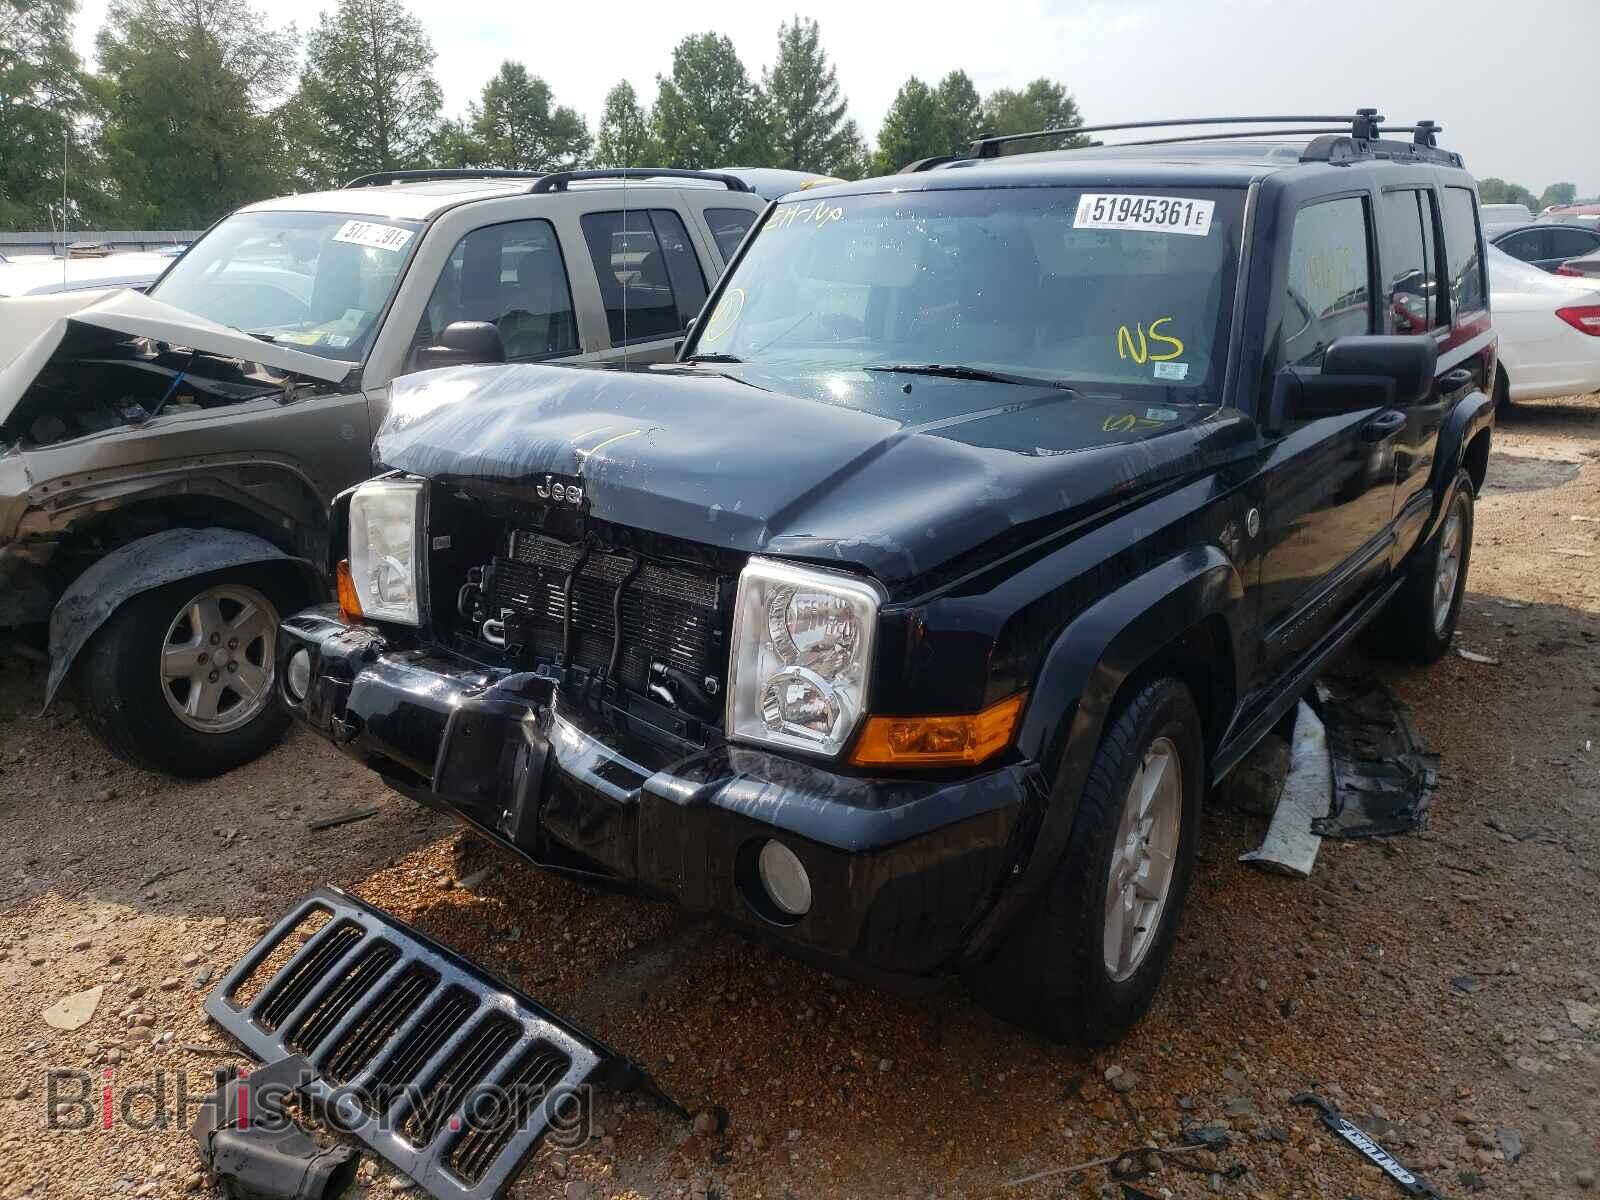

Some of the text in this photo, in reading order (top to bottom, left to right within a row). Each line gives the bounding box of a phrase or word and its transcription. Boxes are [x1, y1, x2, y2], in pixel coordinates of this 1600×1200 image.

[1092, 197, 1194, 226] 51945361
[1196, 211, 1205, 225] E
[1118, 318, 1184, 363] NS
[1337, 1122, 1416, 1184] CENTURY
